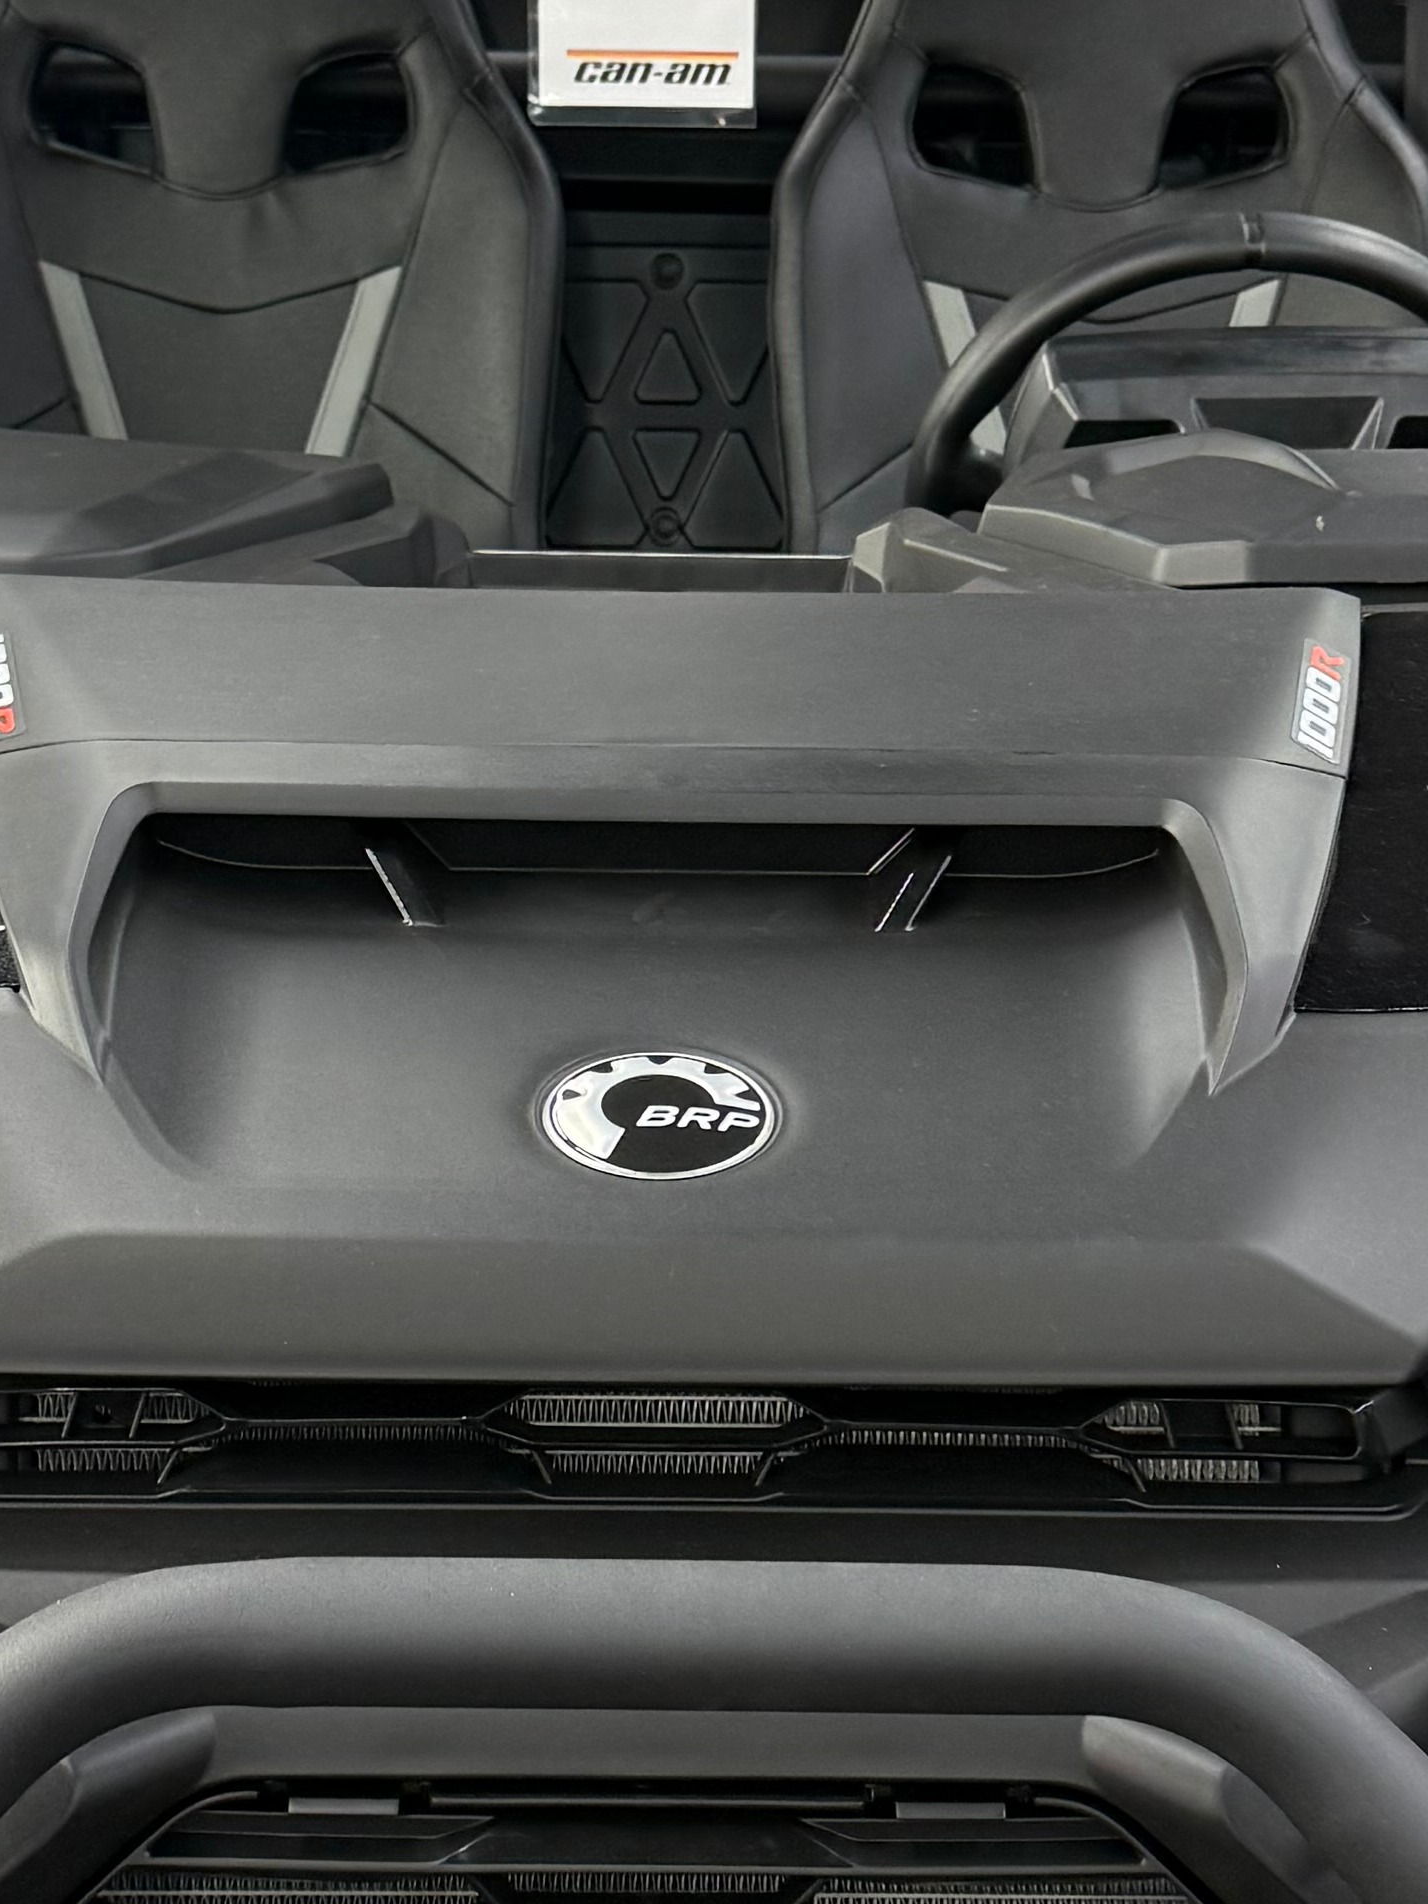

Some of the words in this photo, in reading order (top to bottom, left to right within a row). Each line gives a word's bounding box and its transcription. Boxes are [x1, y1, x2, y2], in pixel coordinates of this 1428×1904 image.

[574, 61, 732, 86] can-am
[1297, 645, 1345, 761] 1000R
[635, 1103, 762, 1134] BRP
